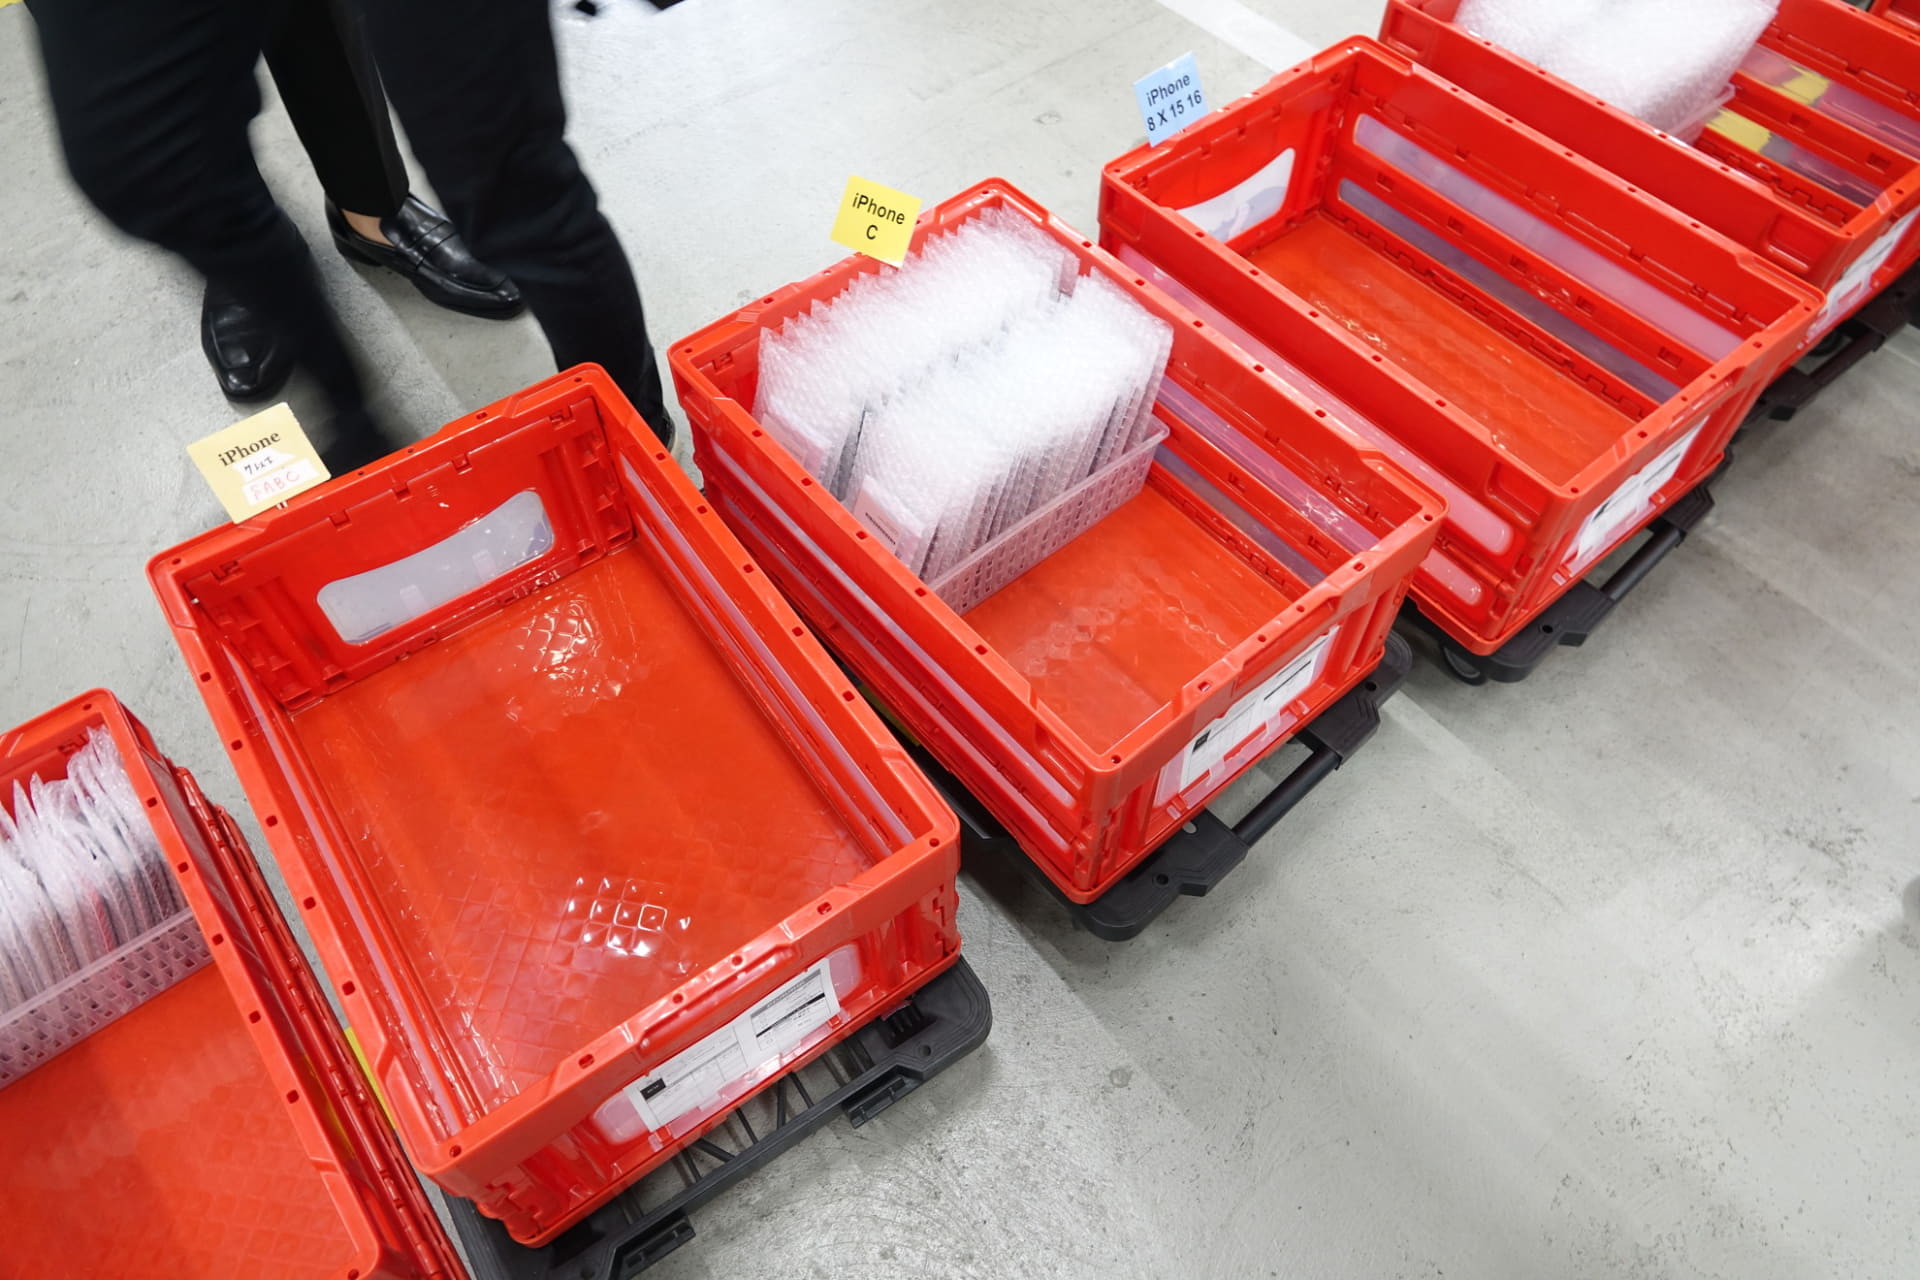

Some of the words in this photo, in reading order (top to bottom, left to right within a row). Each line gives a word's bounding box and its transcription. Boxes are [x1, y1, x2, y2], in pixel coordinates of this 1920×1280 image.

[1146, 74, 1190, 107] iPhone
[1147, 116, 1156, 131] 8
[1157, 108, 1168, 126] X
[1170, 99, 1185, 118] 15
[1187, 89, 1202, 108] 16
[852, 192, 905, 225] iPhone
[866, 224, 879, 240] C
[217, 431, 281, 467] iPhone
